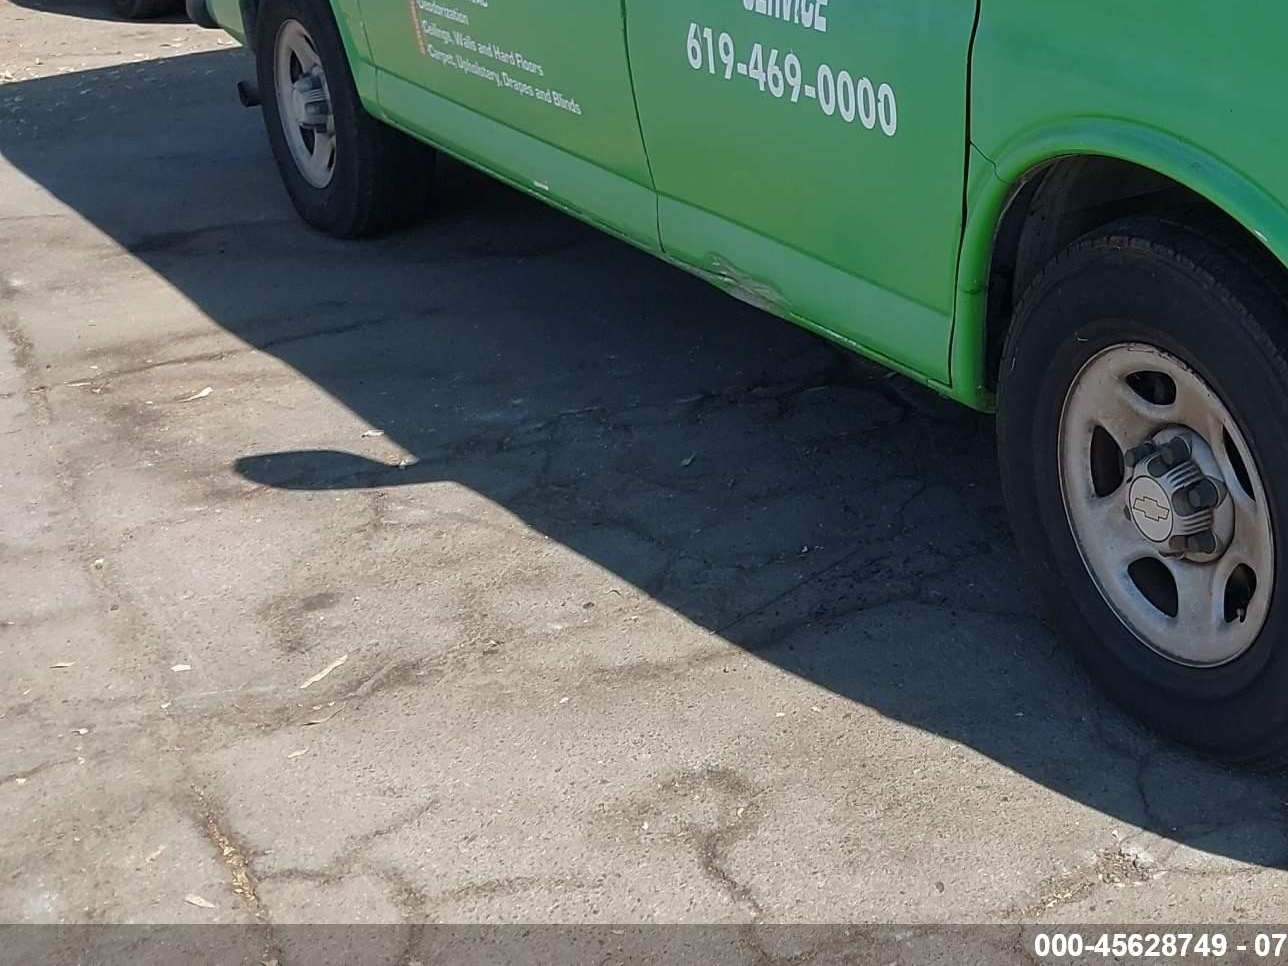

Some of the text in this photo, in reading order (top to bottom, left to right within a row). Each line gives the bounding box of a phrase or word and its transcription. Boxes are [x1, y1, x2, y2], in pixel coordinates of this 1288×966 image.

[453, 30, 477, 52] Walls
[477, 42, 492, 57] and
[492, 44, 516, 66] Hard
[515, 53, 544, 76] Floors
[502, 71, 534, 96] Drapes
[535, 87, 551, 104] and
[552, 91, 582, 115] Blinds
[686, 22, 898, 138] 619-469-0000
